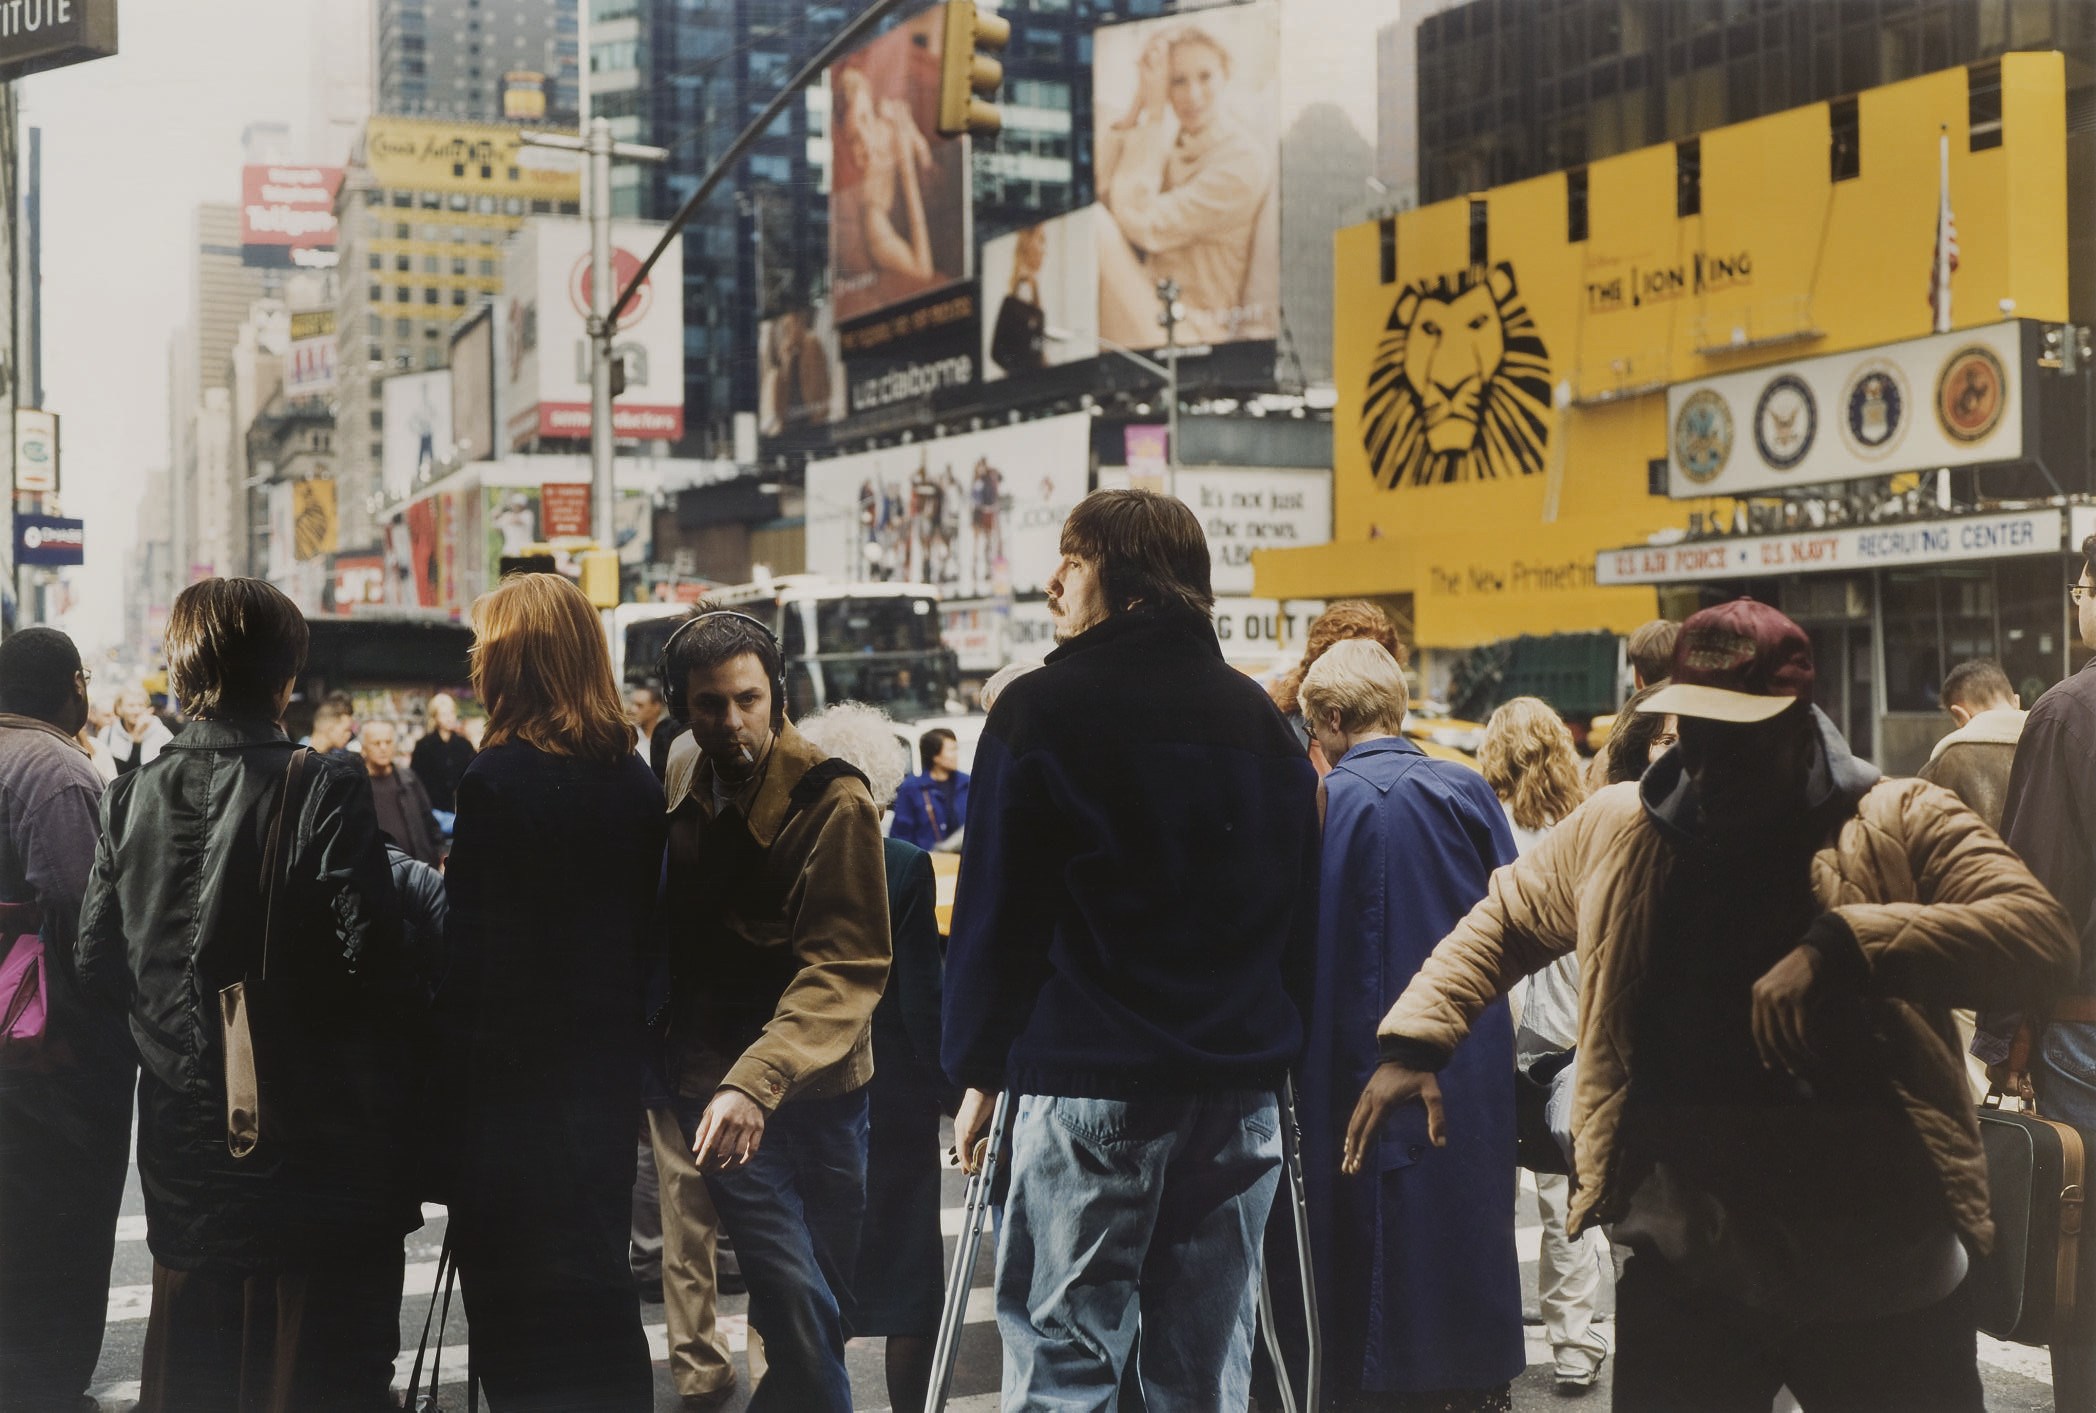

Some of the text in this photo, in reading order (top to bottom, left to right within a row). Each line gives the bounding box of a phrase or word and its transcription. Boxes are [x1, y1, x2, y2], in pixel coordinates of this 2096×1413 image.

[1630, 264, 1685, 308] LION
[1693, 251, 1752, 296] KING
[1674, 546, 1728, 573] FORCE
[1791, 538, 1840, 563] NAVY
[1960, 520, 2034, 550] CENTER
[1430, 564, 1462, 596] The
[1245, 615, 1296, 640] OUT
